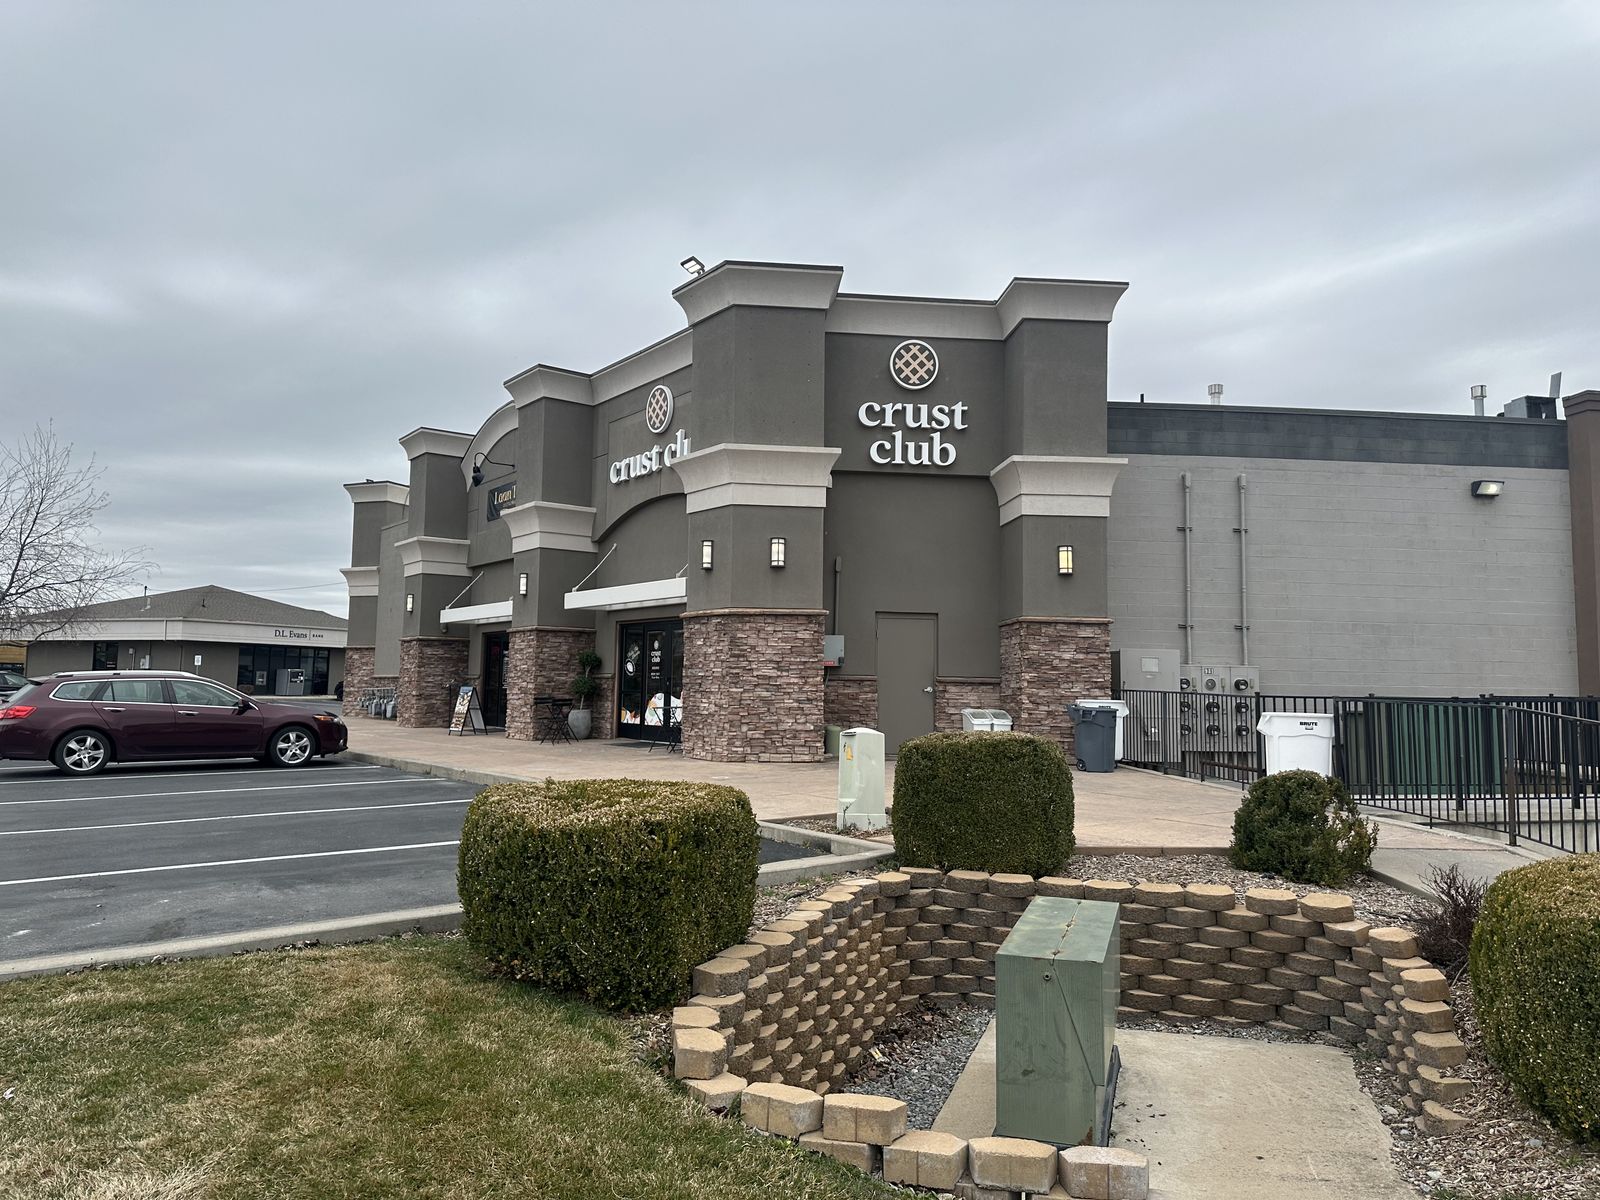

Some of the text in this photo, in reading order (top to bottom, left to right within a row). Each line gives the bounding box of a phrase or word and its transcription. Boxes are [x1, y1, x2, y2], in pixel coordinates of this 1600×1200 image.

[857, 401, 969, 431] crust
[609, 428, 692, 484] crust cl
[869, 430, 957, 467] club
[289, 630, 308, 639] Evans
